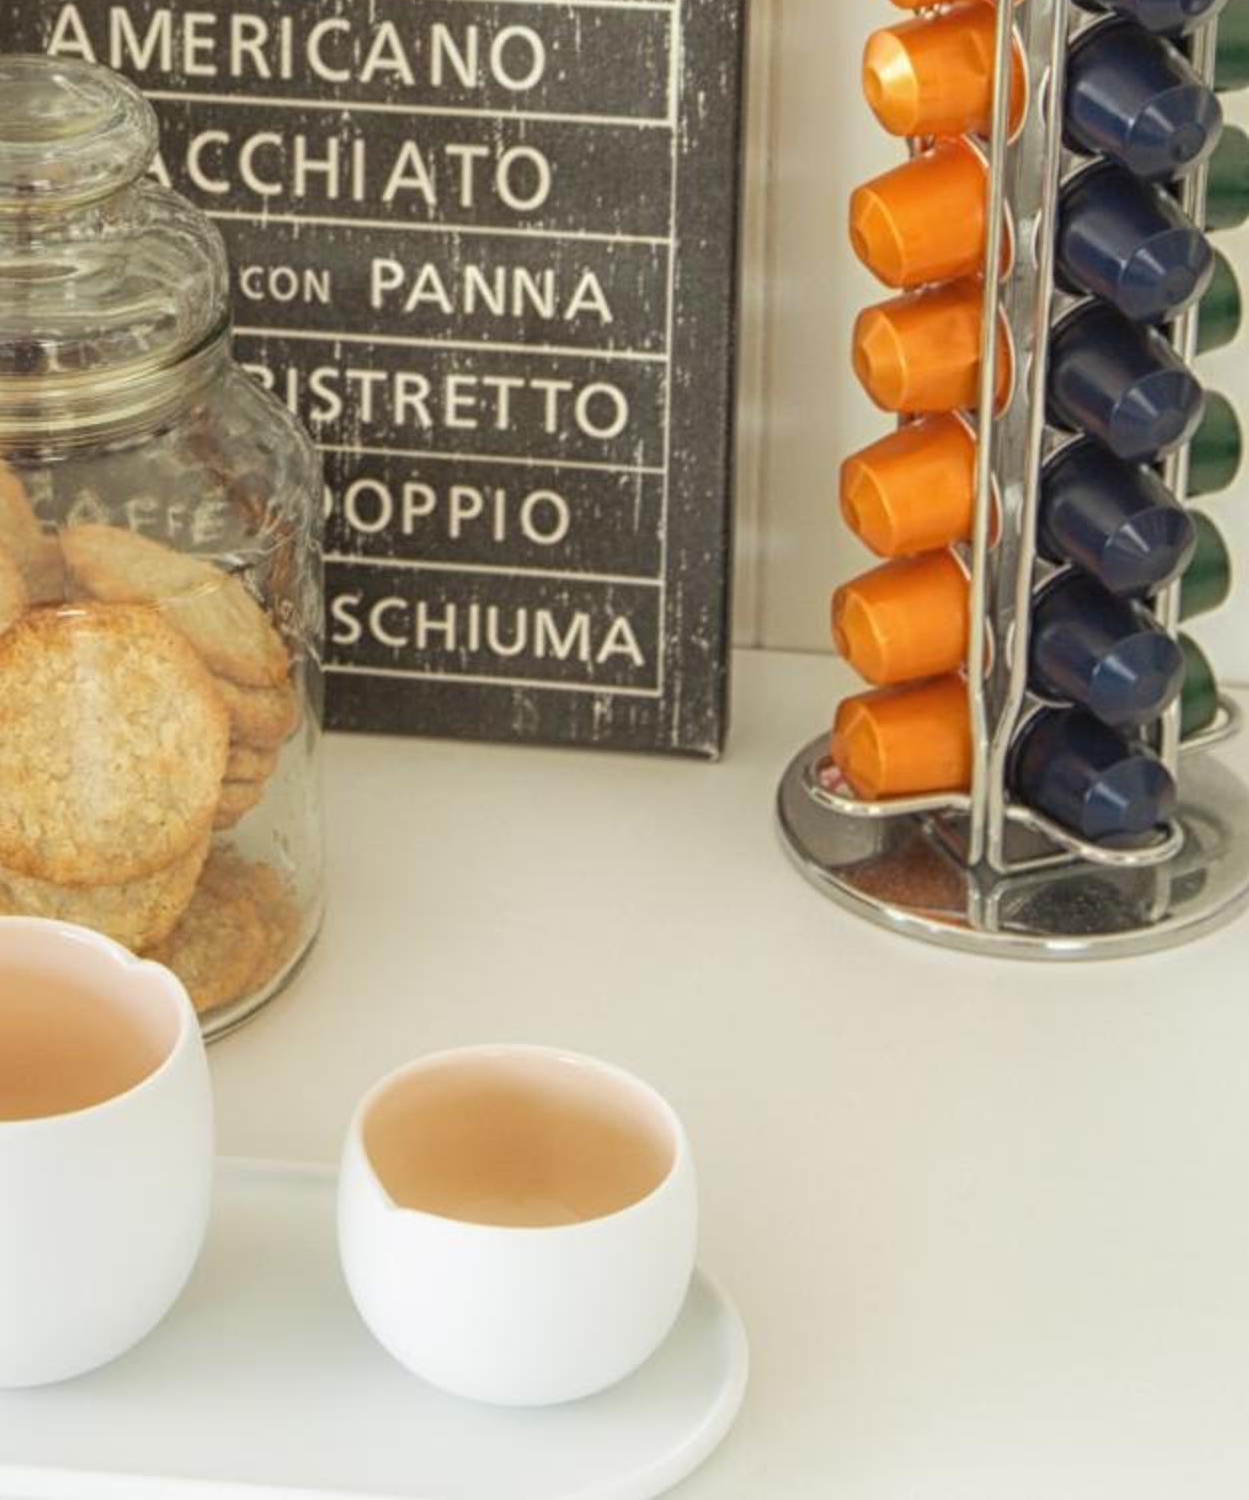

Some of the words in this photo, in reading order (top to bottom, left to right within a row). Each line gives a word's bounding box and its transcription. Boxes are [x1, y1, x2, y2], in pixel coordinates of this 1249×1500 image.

[46, 3, 547, 91] AMERICANO
[240, 266, 330, 303] CON
[371, 257, 614, 324] PANNA
[324, 479, 570, 545] OPPIO
[331, 595, 644, 667] SCHIUMA
